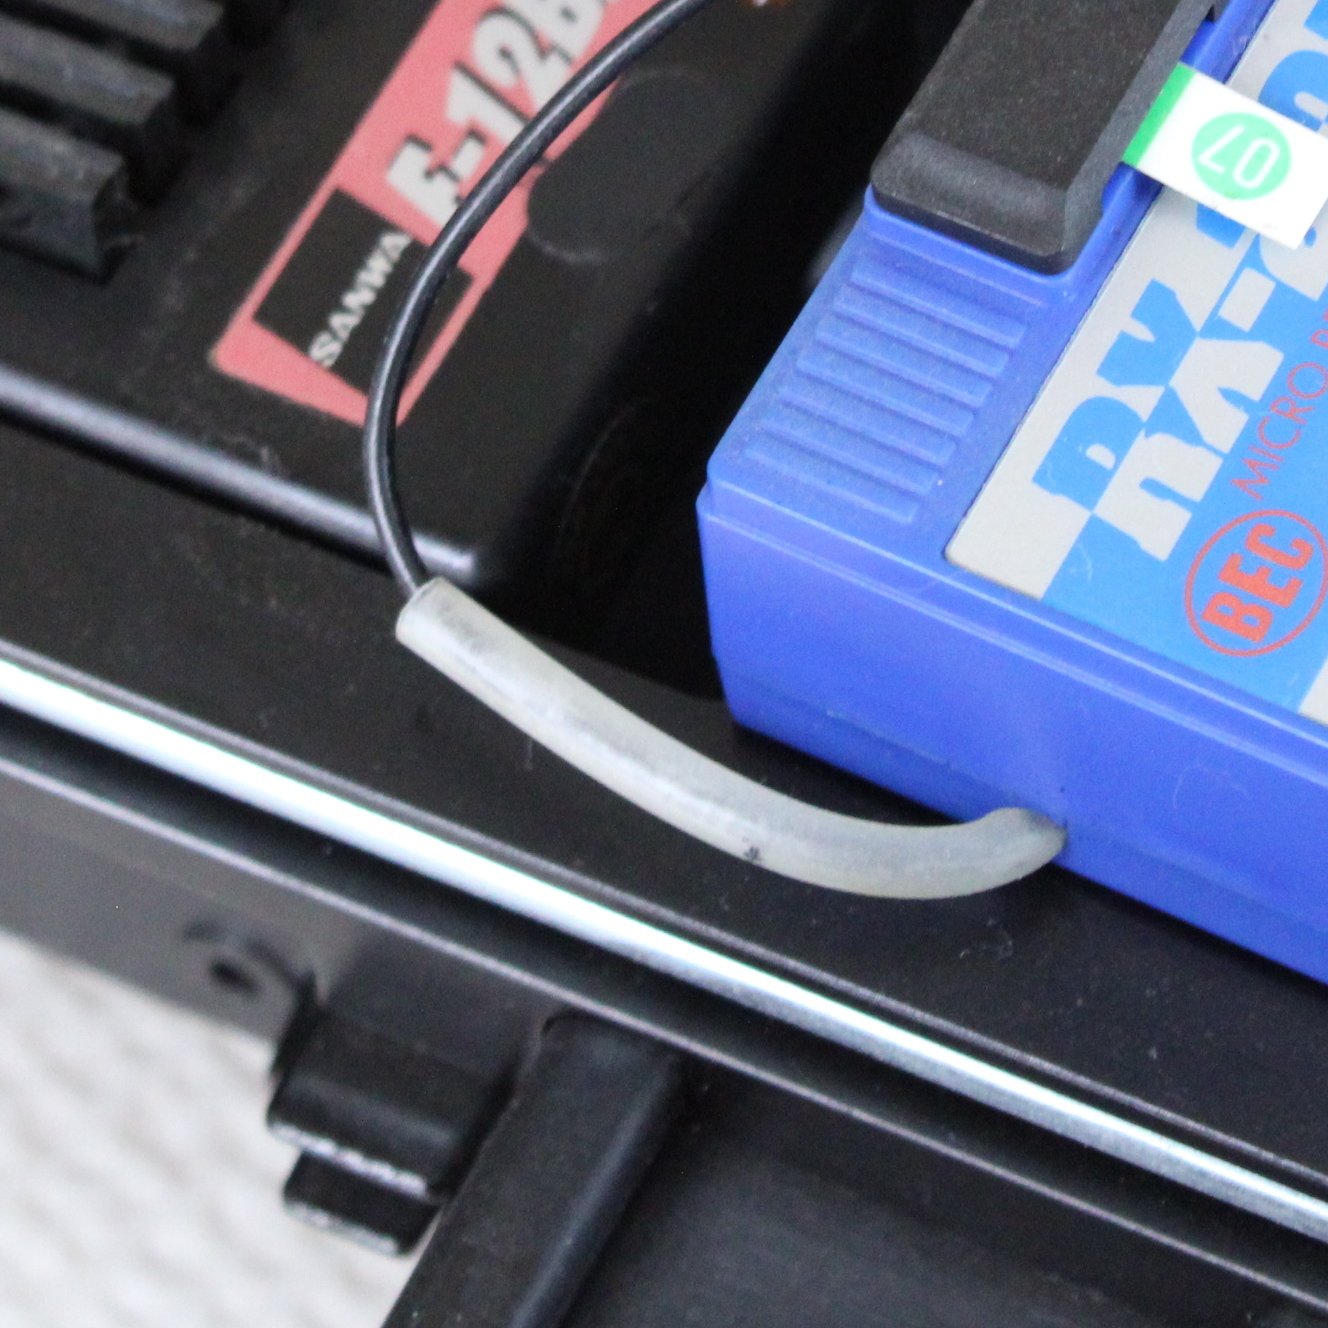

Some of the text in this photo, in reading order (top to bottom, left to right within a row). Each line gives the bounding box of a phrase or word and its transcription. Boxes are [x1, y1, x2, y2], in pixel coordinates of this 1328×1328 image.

[1197, 124, 1281, 190] 07
[309, 231, 412, 368] SANWA
[1200, 522, 1314, 644] BEC
